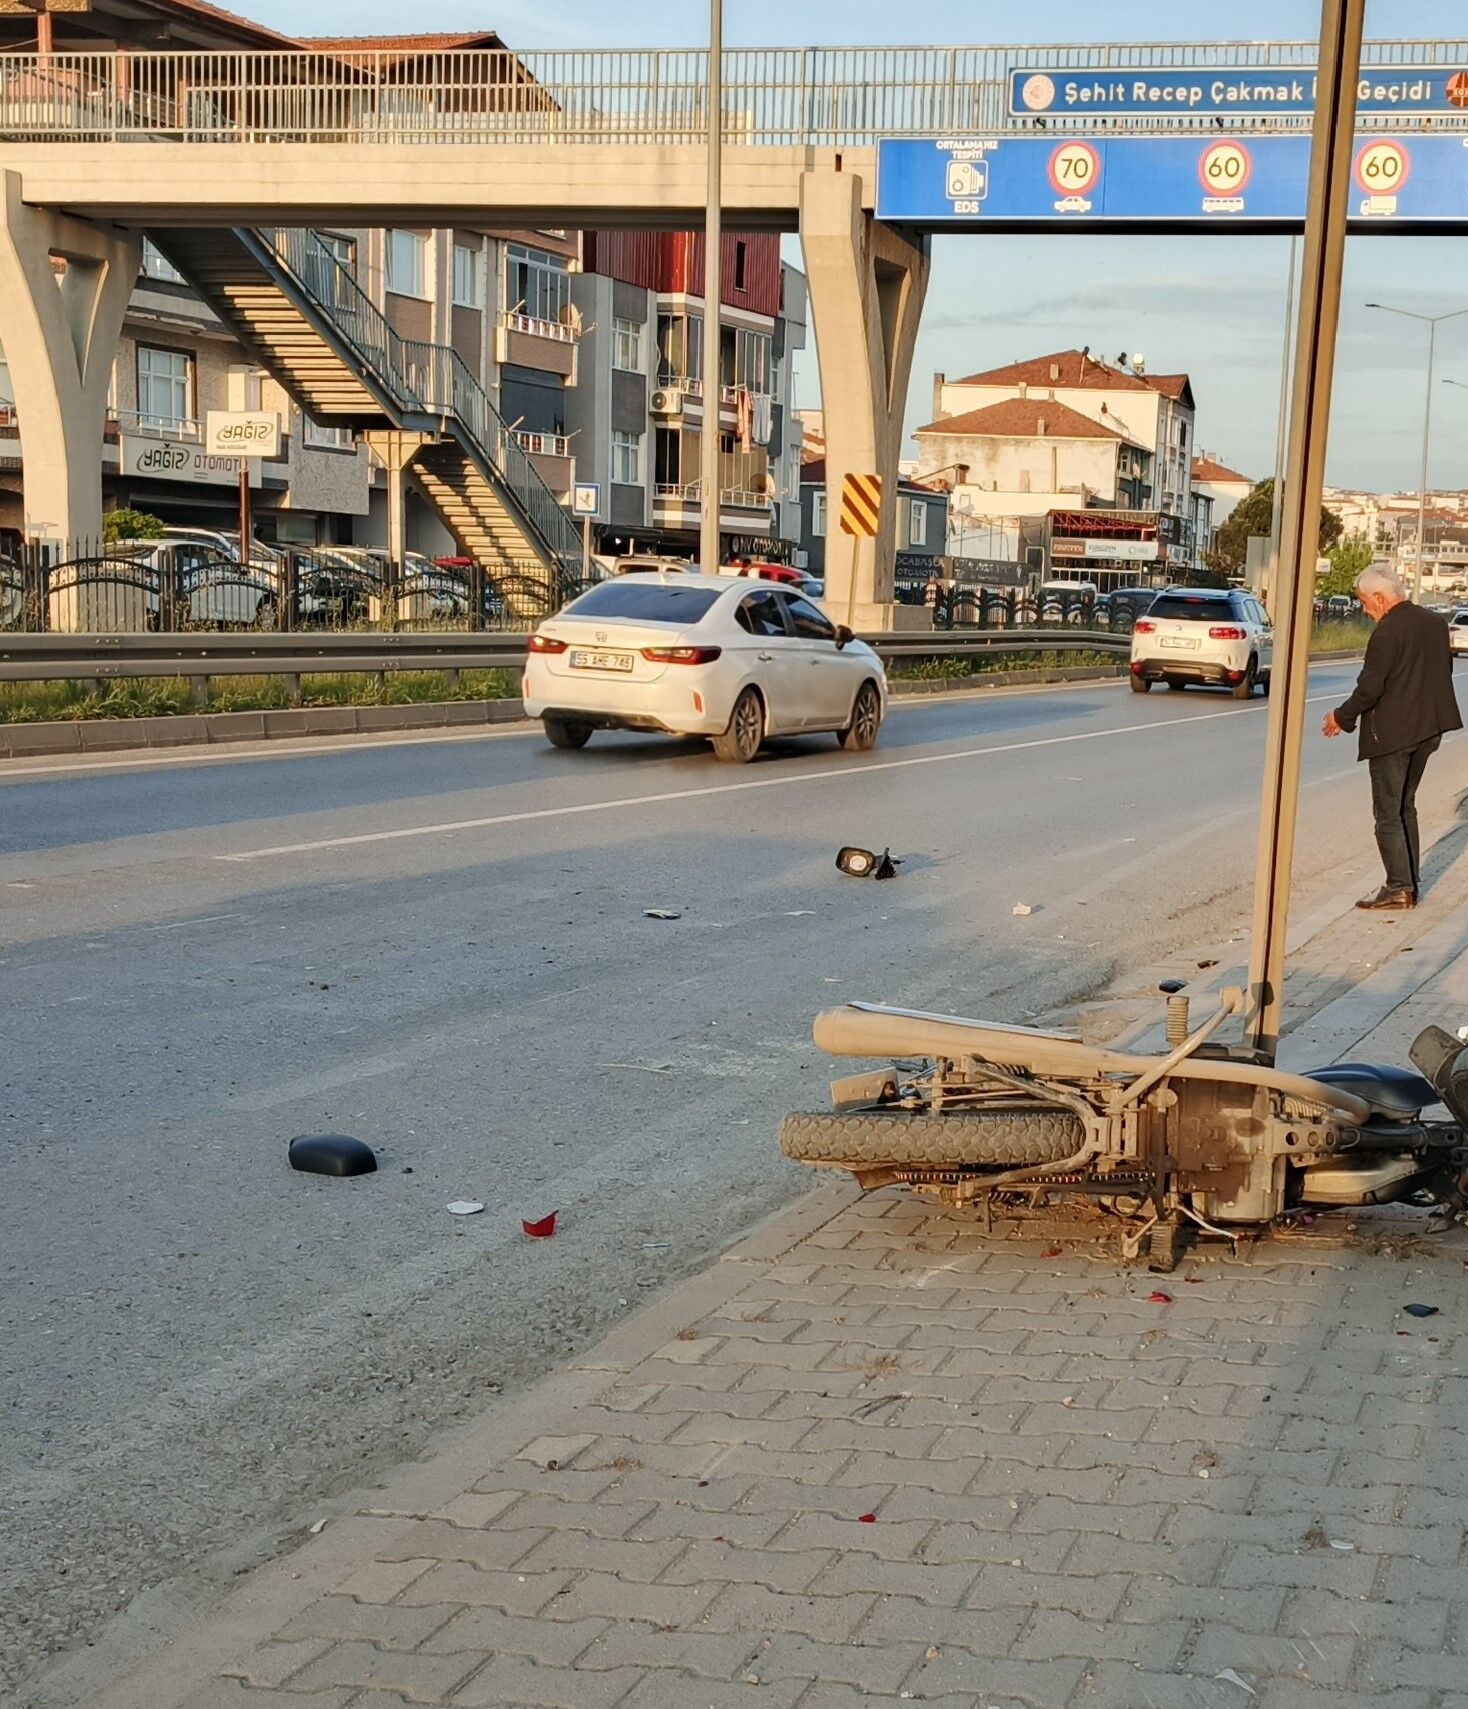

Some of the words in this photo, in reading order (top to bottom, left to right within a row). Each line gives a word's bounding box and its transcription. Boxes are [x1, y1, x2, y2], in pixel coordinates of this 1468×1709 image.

[1064, 82, 1125, 105] Şehit
[1132, 81, 1202, 106] Recep
[1210, 81, 1304, 105] Çakmak
[1357, 79, 1431, 103] Geçidi
[936, 140, 983, 151] ORTALAMA
[1060, 158, 1089, 179] 70
[1208, 157, 1241, 178] 60
[1365, 156, 1399, 178] 60
[954, 201, 979, 214] EDS
